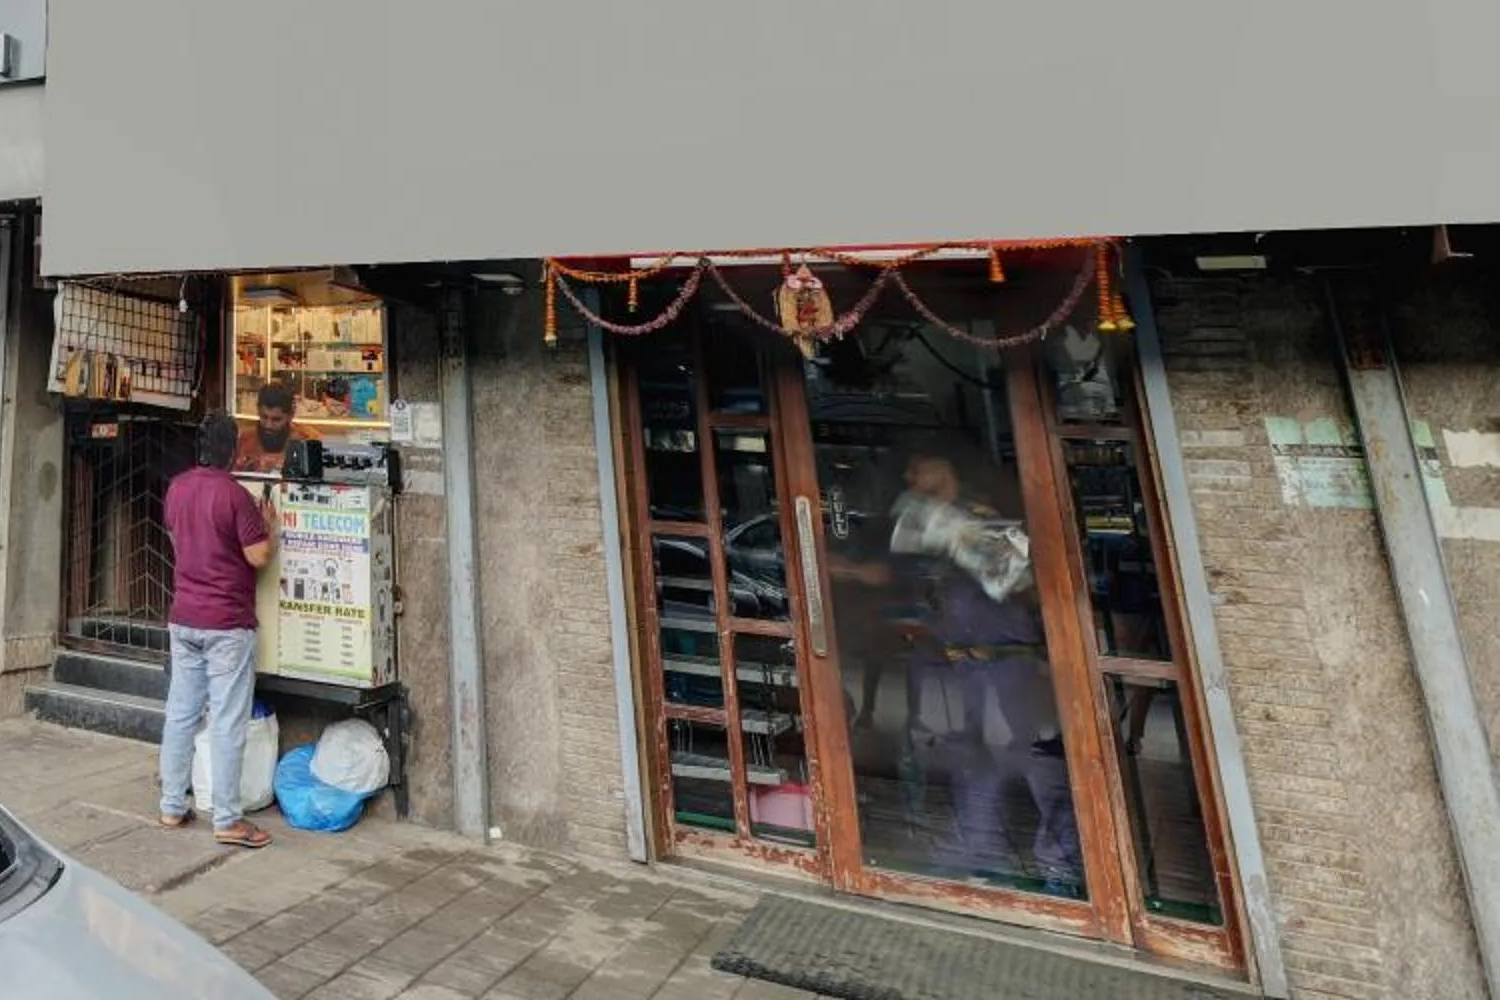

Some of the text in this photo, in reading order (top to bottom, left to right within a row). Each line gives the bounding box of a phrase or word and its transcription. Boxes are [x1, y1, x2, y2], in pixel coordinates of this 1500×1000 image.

[302, 511, 365, 535] TELECOM
[279, 600, 331, 616] RANSFER
[335, 606, 366, 620] RATE
